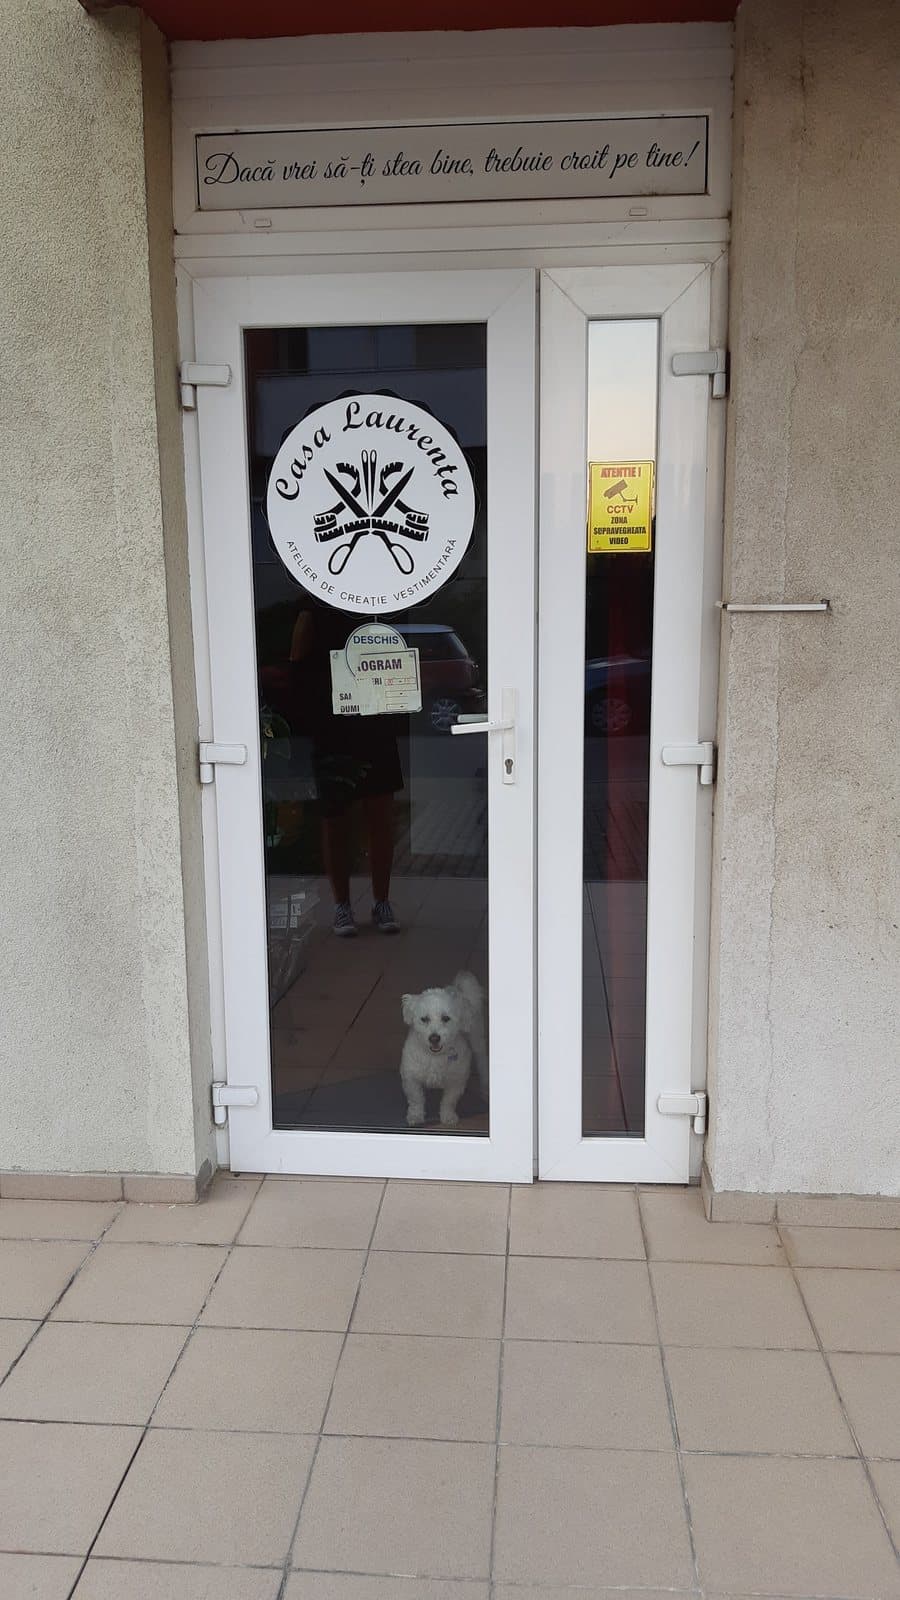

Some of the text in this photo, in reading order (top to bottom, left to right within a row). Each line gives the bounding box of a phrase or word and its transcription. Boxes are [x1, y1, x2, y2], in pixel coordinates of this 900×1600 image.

[204, 152, 276, 185] Dacă
[282, 160, 318, 181] vrei
[382, 151, 423, 177] stea
[430, 149, 474, 176] bine,
[484, 146, 554, 173] trebuie
[560, 144, 609, 171] croit
[608, 149, 640, 179] pe
[645, 140, 700, 168] tine!
[275, 401, 459, 501] Casa Laurența
[607, 505, 634, 514] CCTV
[611, 516, 628, 525] ZONA
[593, 526, 647, 536] SUPRAVEGHEATA
[609, 537, 629, 545] VIDEO
[286, 540, 318, 582] ATELIER
[320, 581, 336, 595] DE
[353, 635, 399, 645] DESCHIS
[357, 658, 402, 672] OGRAM
